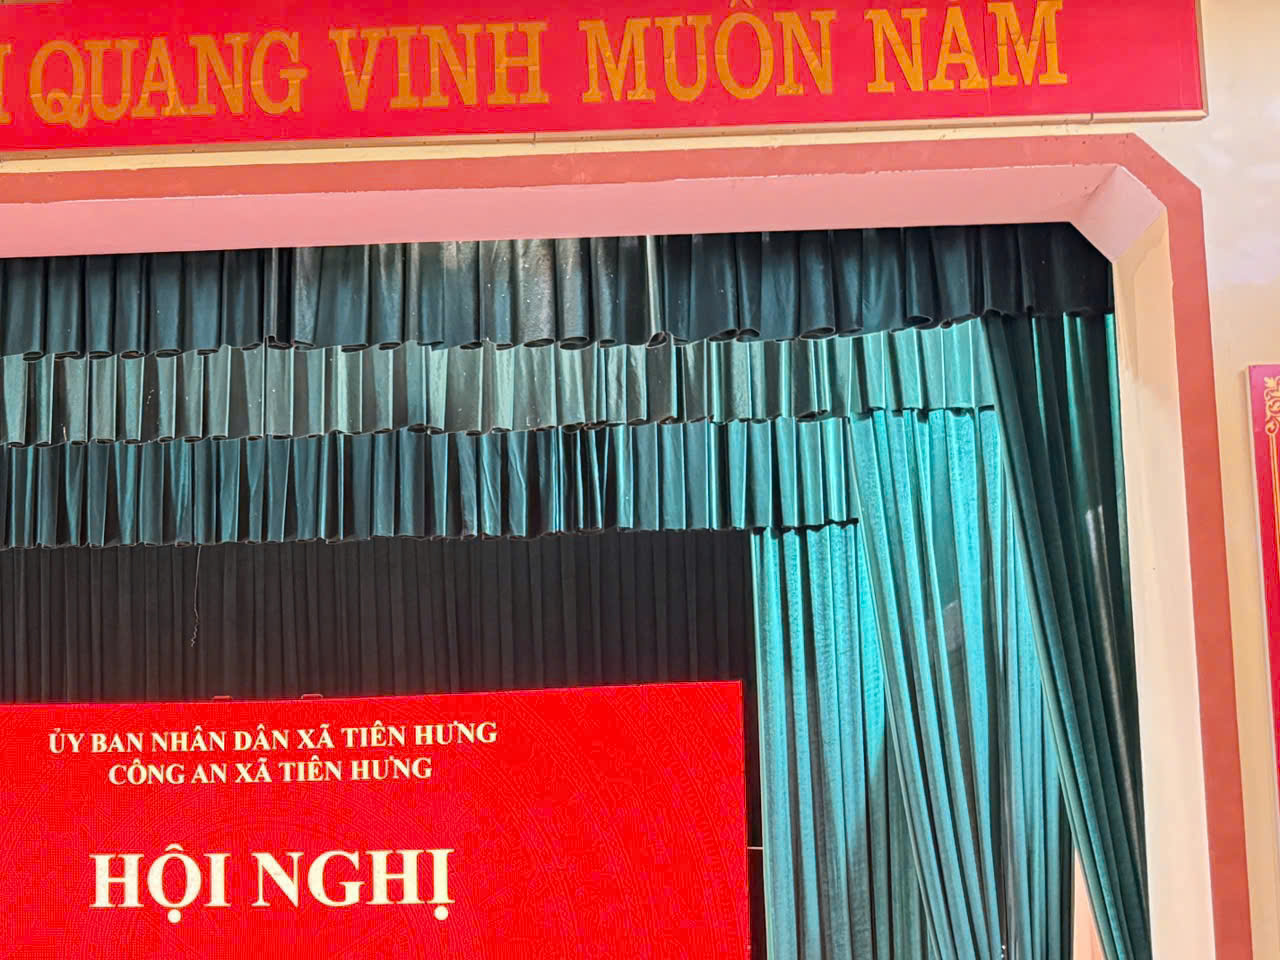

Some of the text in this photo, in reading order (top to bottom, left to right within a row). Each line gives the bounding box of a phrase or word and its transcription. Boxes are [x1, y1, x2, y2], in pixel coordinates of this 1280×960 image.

[29, 31, 308, 128] QUANG
[328, 21, 549, 111] VINH
[579, 0, 837, 103] MUÔN
[48, 719, 498, 754] ỦY BAN NHÂN DÂN XÃ TIÊN HƯNG
[108, 754, 433, 786] CÔNG AN XÃ TIÊN HƯNG
[88, 843, 456, 924] HỘI NGHỊ
